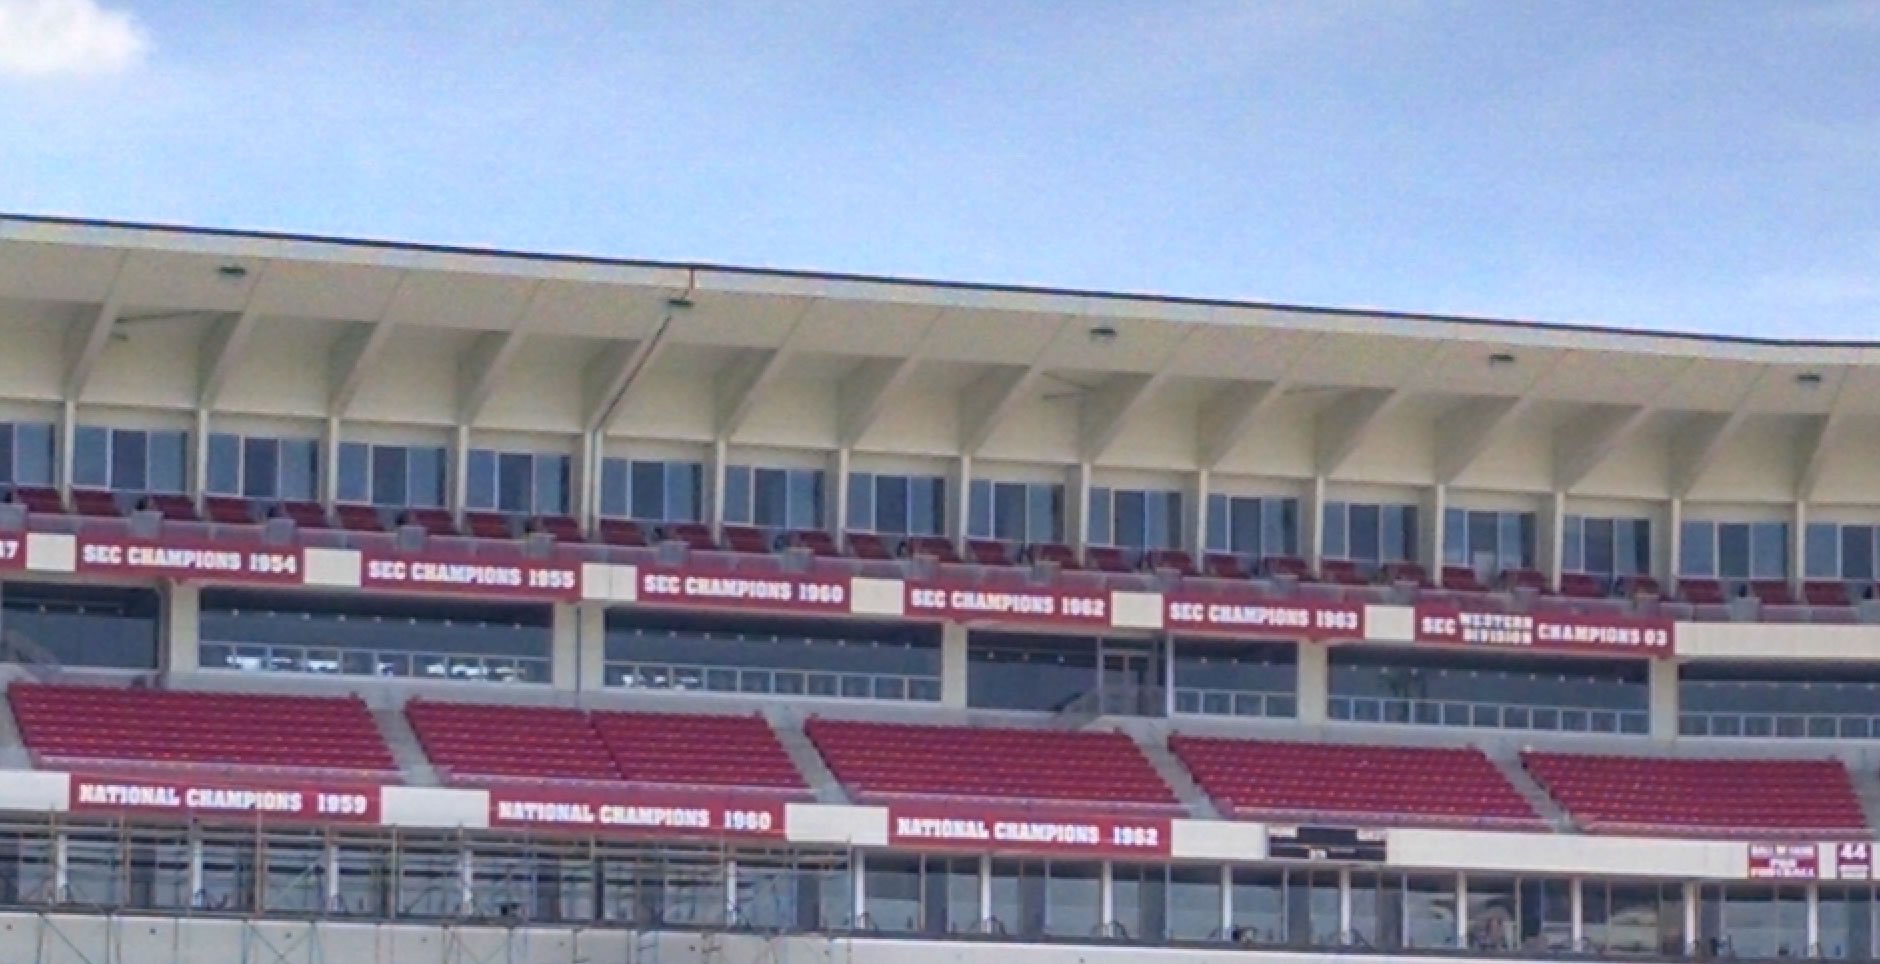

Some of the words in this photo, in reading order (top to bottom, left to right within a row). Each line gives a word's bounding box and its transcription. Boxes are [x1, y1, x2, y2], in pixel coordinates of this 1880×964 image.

[83, 545, 121, 563] SEC
[127, 547, 241, 570] CHAMPIONS
[249, 554, 297, 573] 1954
[369, 561, 405, 579] SEC
[411, 563, 521, 585] CHAMPIONS
[529, 569, 575, 587] 1955
[645, 575, 679, 593] SEC
[685, 577, 791, 599] CHAMPIONS
[799, 584, 843, 603] 1960
[911, 589, 945, 607] SEC
[951, 591, 1053, 613] CHAMPIONS
[1063, 597, 1105, 616] 1962
[1171, 603, 1203, 621] SEC
[1209, 605, 1309, 627] CHAMPIONS
[1423, 617, 1455, 635] SEC
[1459, 613, 1533, 629] WESTERN
[1538, 623, 1640, 645] CHAMPIONS
[1645, 629, 1667, 645] 03
[1463, 627, 1532, 645] DIVISION
[79, 785, 181, 805] NATIONAL
[185, 789, 302, 811] CHAMPIONS
[317, 793, 367, 813] 1959
[499, 801, 595, 823] NATIONAL
[599, 805, 709, 827] CHAMPIONS
[724, 811, 771, 831] 1960
[897, 817, 989, 839] NATIONAL
[993, 822, 1099, 843] CHAMPIONS
[1113, 827, 1157, 845] 1962
[1840, 842, 1867, 859] 44
